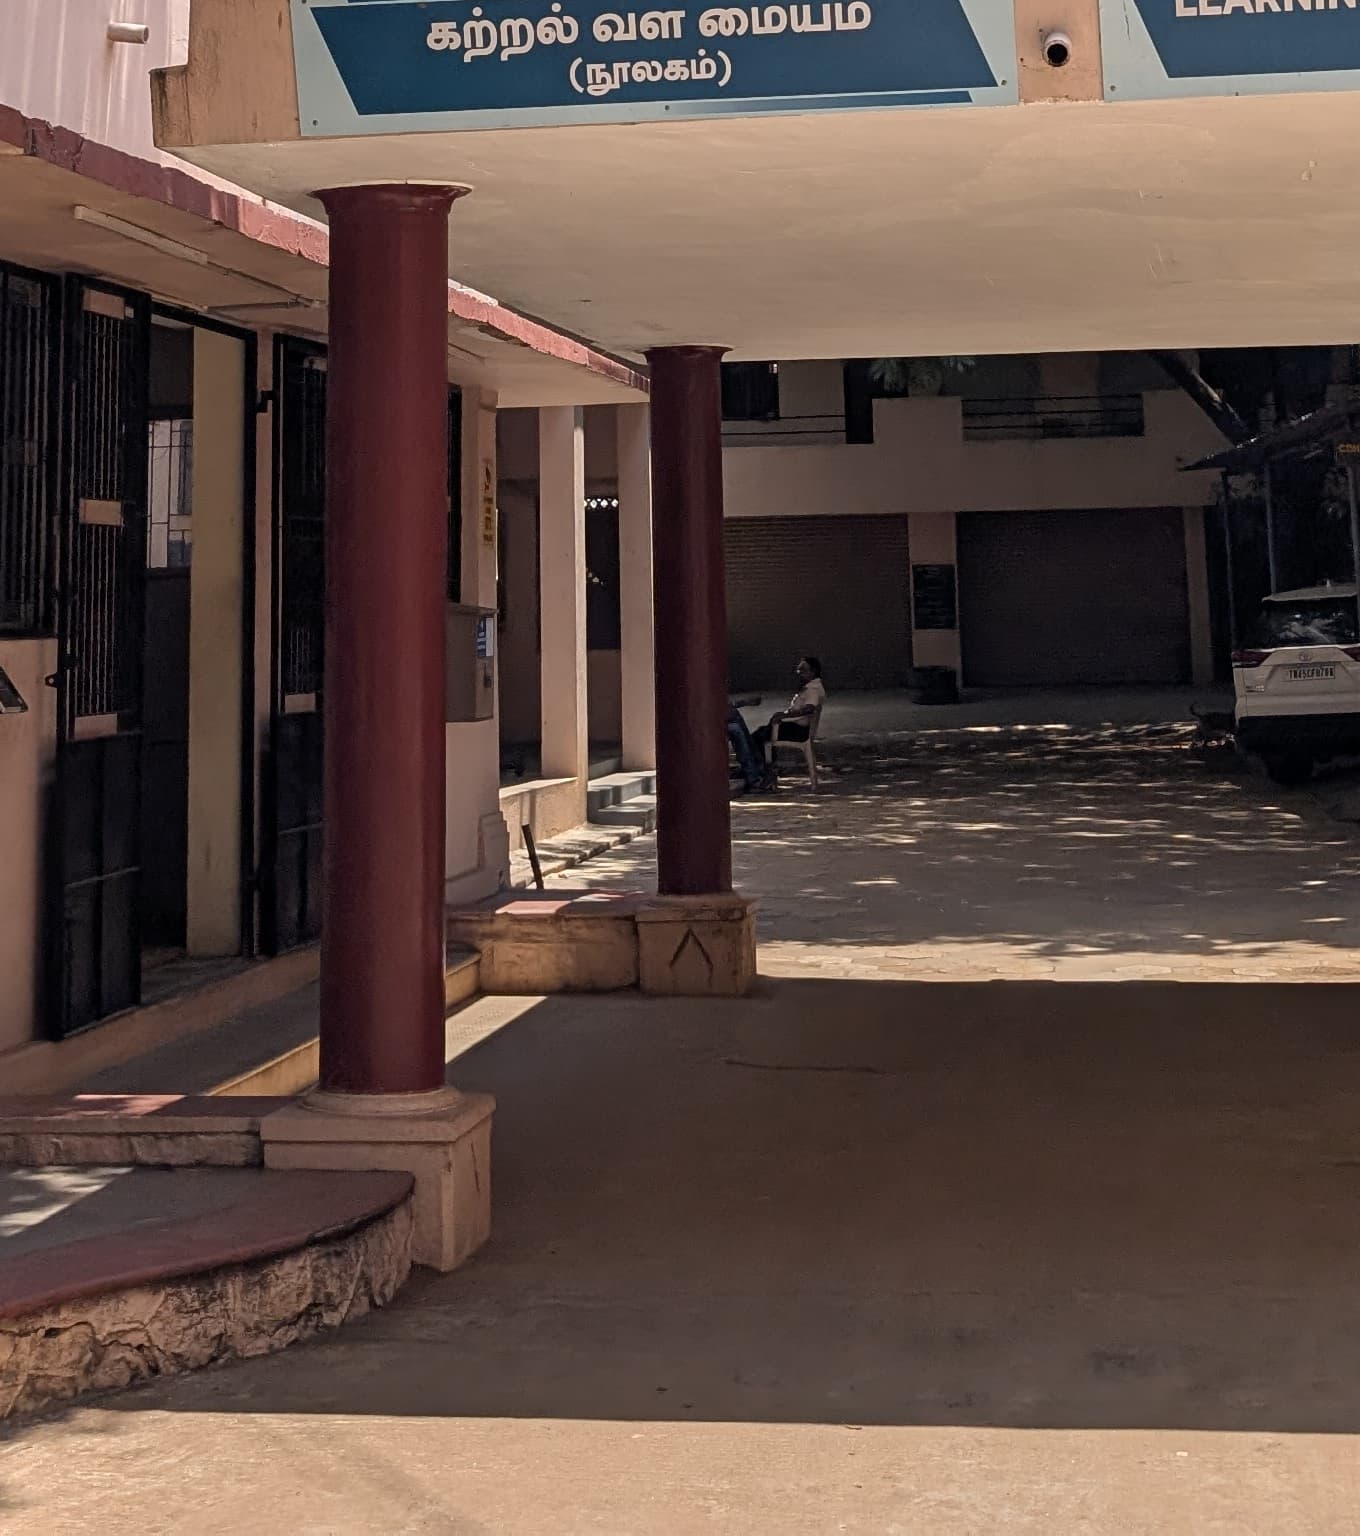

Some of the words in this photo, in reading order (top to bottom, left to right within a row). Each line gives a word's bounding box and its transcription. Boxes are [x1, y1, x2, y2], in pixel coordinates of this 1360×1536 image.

[426, 2, 578, 62] கற்றல்
[592, 10, 685, 43] வள
[570, 48, 732, 96] (நூலகம்)
